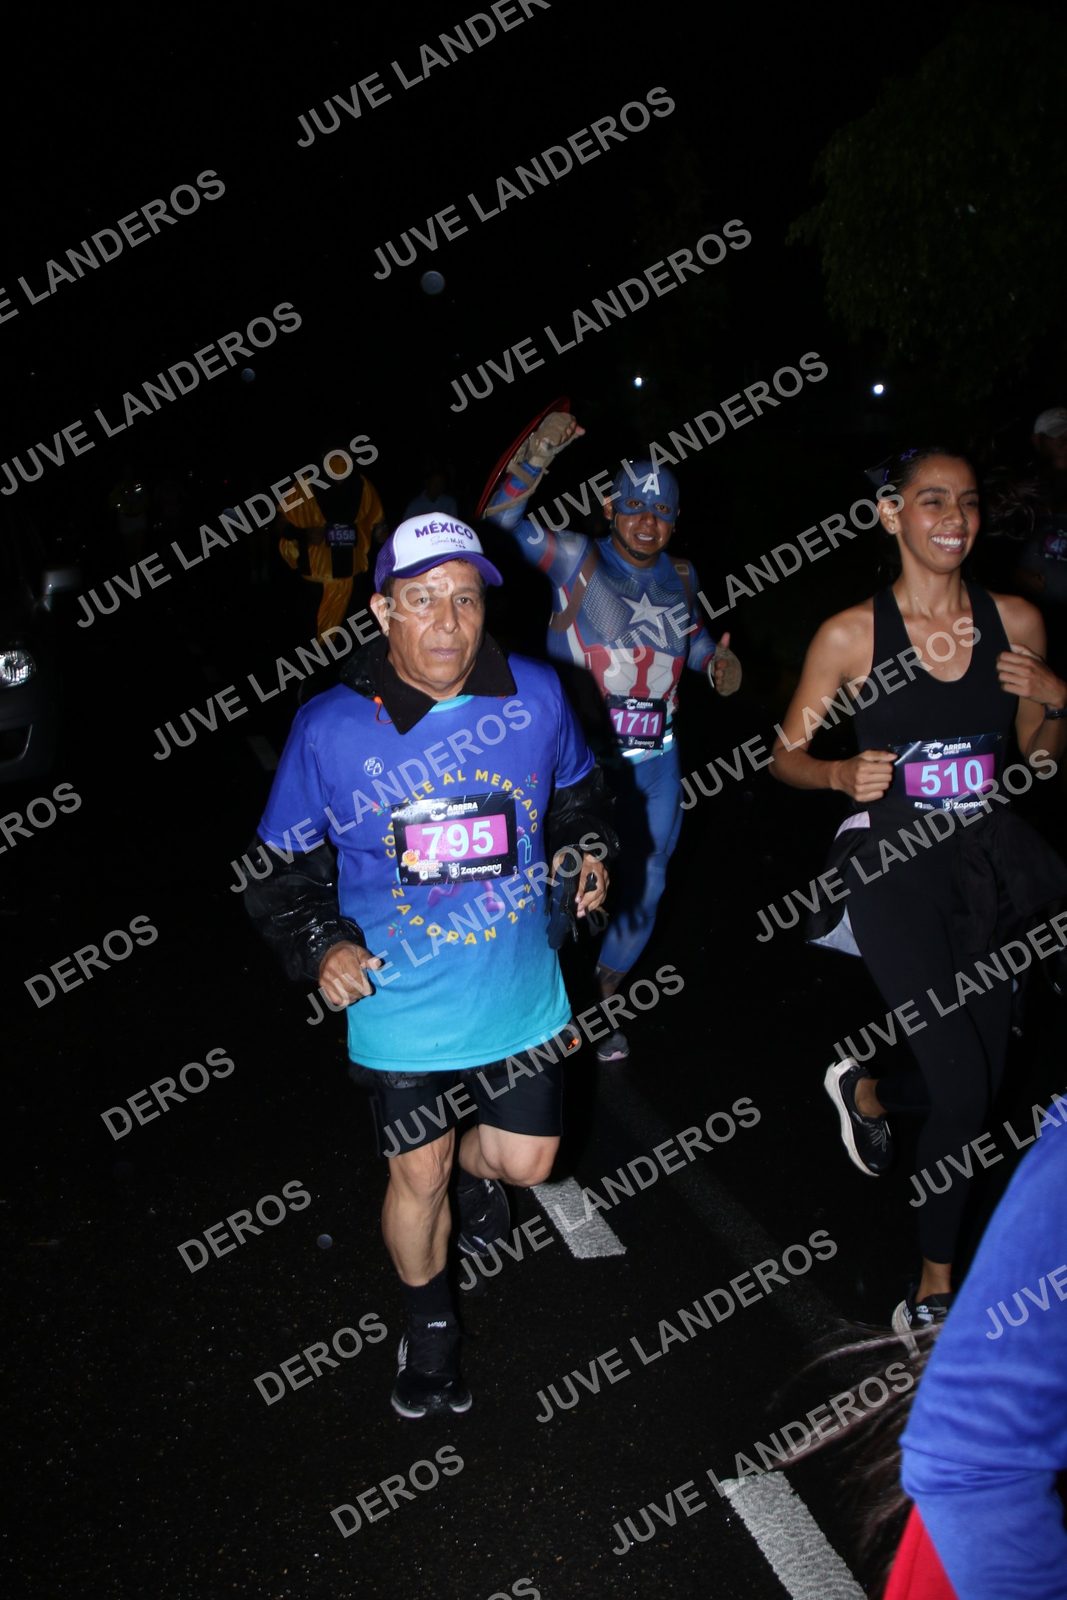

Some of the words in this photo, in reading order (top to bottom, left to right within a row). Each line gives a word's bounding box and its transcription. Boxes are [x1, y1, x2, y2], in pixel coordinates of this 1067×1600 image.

[639, 473, 660, 496] A
[415, 520, 474, 540] MÉXICO
[613, 711, 659, 734] 1711
[921, 760, 983, 796] 510
[443, 770, 467, 786] AL
[475, 769, 538, 833] MERCADO
[953, 799, 990, 811] Zapopa
[422, 820, 493, 861] 795
